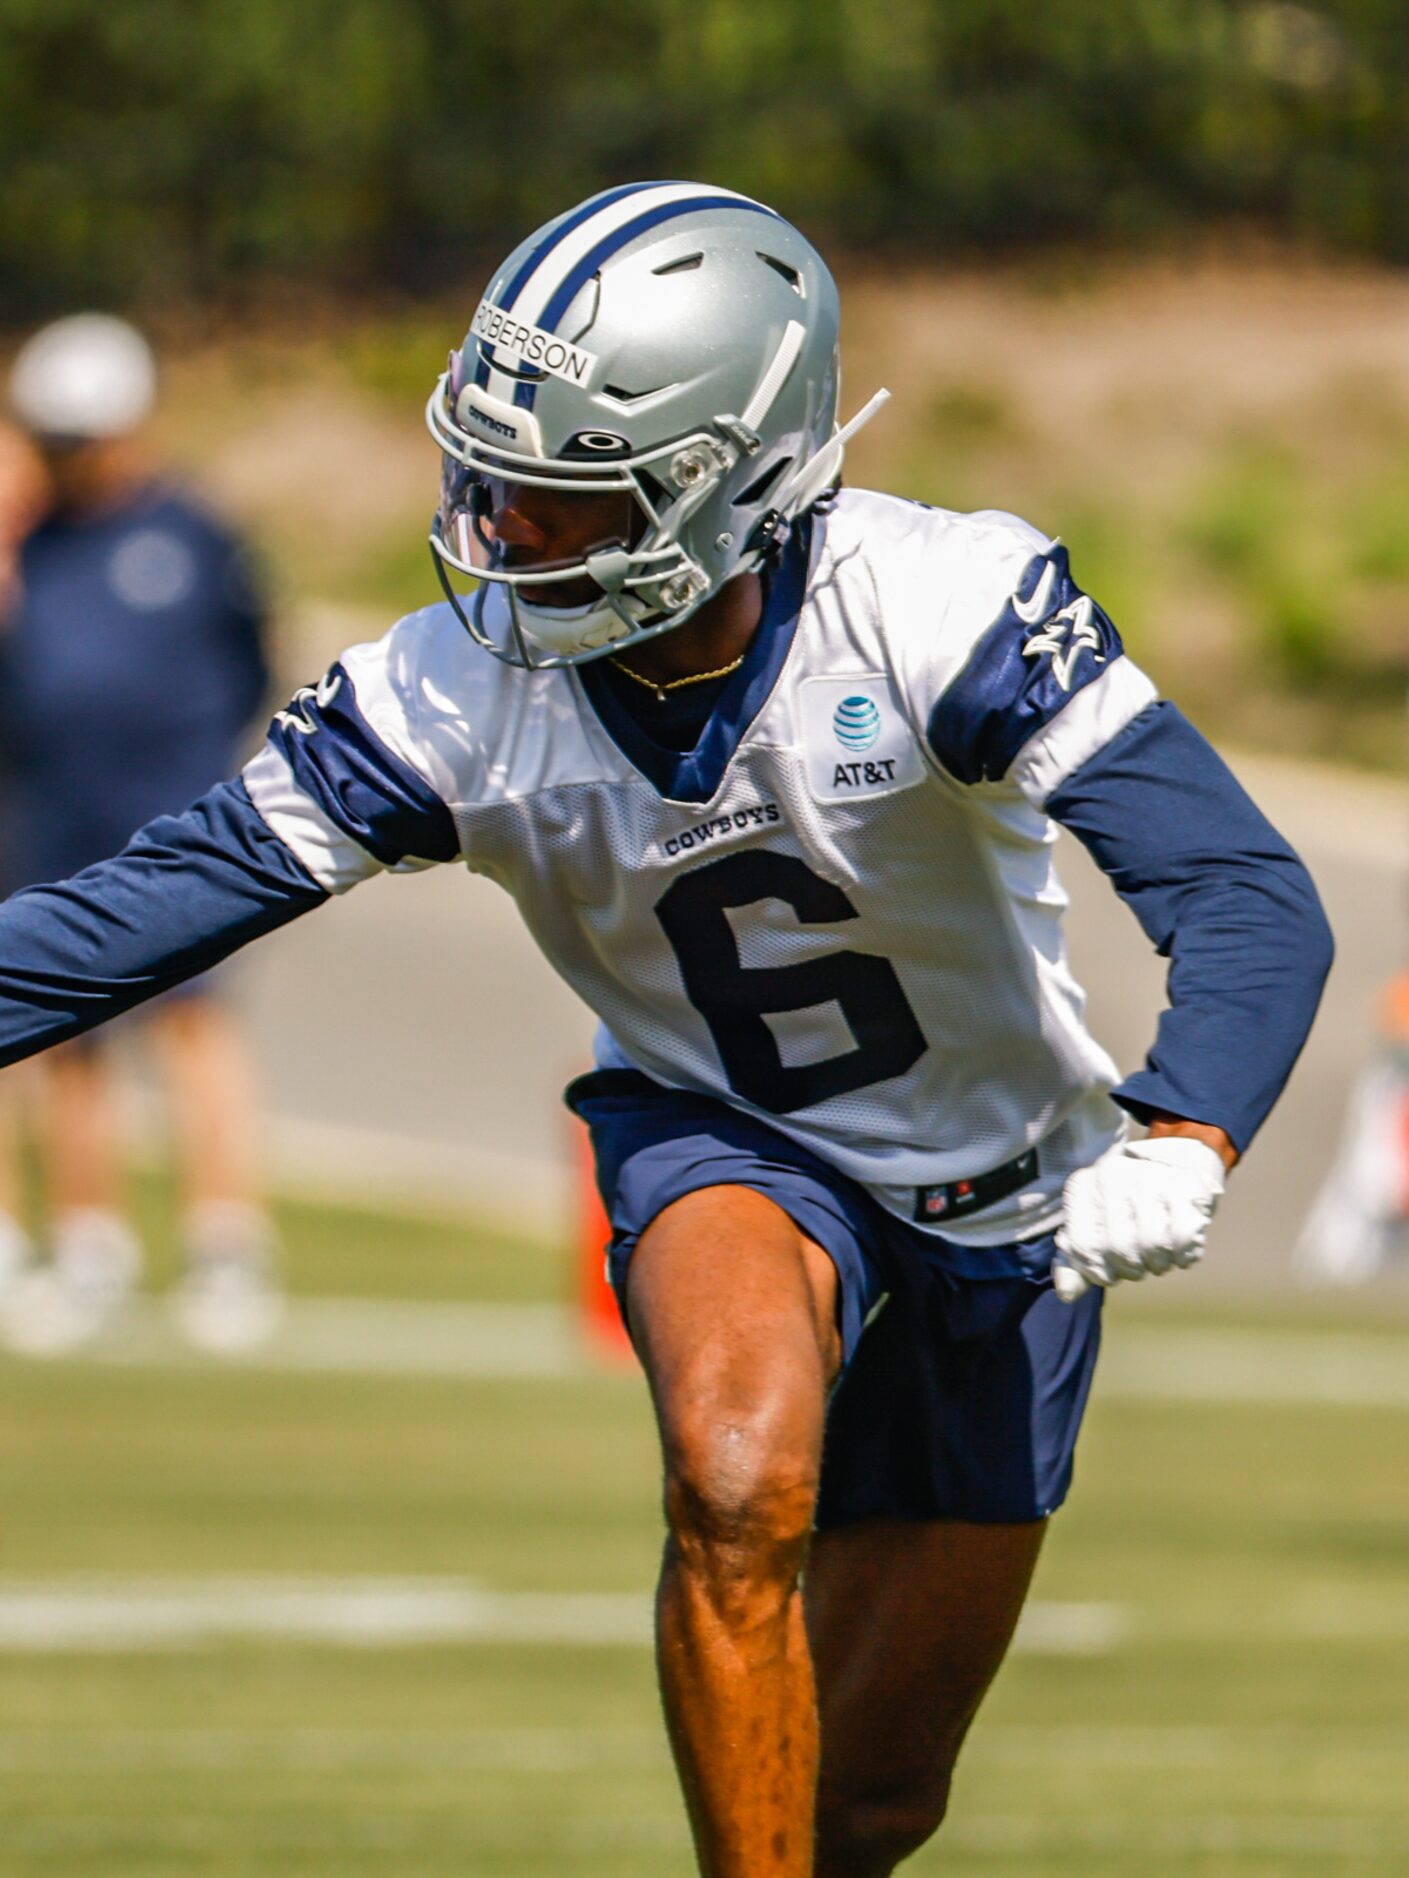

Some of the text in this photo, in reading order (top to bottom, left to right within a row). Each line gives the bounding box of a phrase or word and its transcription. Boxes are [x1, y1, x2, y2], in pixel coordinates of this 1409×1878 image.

[468, 404, 518, 440] COWBOYS
[832, 758, 897, 788] AT&T
[664, 803, 780, 857] COWBOYS
[653, 848, 930, 1115] 6
